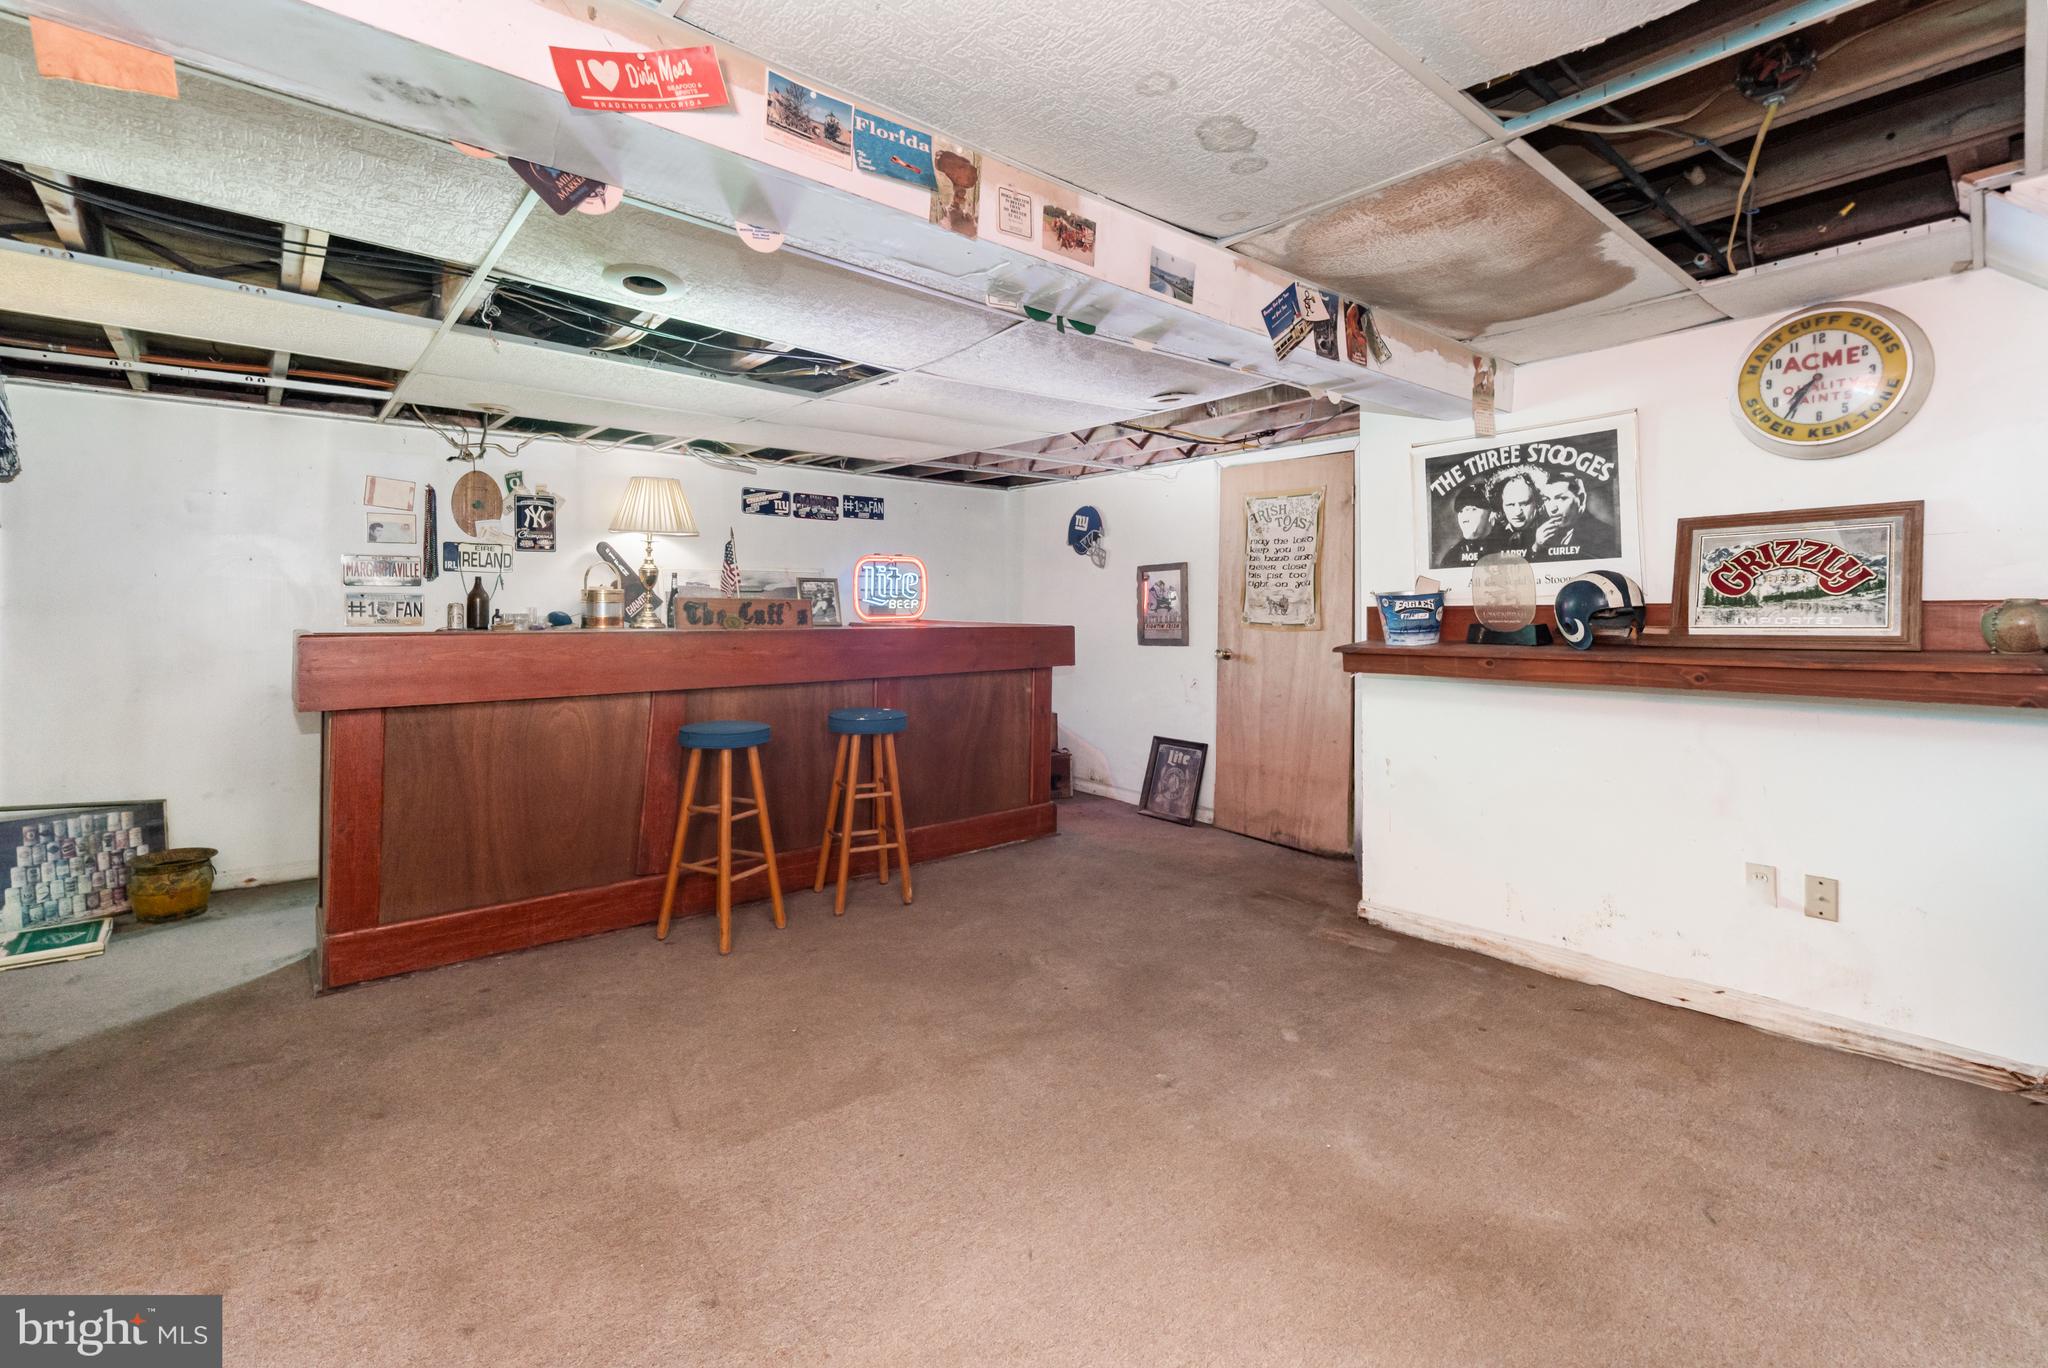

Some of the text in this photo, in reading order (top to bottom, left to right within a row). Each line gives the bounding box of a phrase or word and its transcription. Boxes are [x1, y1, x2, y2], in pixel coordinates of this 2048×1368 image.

[576, 59, 591, 89] I
[624, 61, 664, 99] Dirty
[854, 115, 931, 154] Florida
[1788, 315, 1842, 335] CUFF
[1849, 316, 1901, 355] SIGNS
[1812, 332, 1826, 345] 12
[1789, 342, 1799, 354] 11
[1861, 345, 1869, 357] 2
[1769, 358, 1783, 371] 10
[1783, 345, 1861, 375] ACME
[1765, 379, 1773, 390] 9
[1841, 402, 1849, 413] 5
[1746, 399, 1795, 436] SUPER
[1815, 411, 1823, 422] 6
[1430, 443, 1615, 497] THE THREE STOOGES
[843, 499, 860, 513] #1
[868, 501, 884, 514] FAN
[523, 504, 547, 529] NY
[1249, 504, 1288, 524] IRISH
[1275, 515, 1314, 532] TOAST
[1273, 537, 1289, 545] the
[1273, 547, 1292, 555] you
[1461, 552, 1479, 561] MOE
[1547, 545, 1581, 556] CURLEY
[346, 561, 420, 578] MARGARITAVILLE
[444, 560, 458, 569] IRL
[1282, 563, 1307, 571] close
[1708, 538, 1879, 598] GRIZZLY
[1266, 572, 1283, 580] fist
[1288, 571, 1307, 579] too
[1765, 574, 1809, 584] BEER
[861, 565, 919, 606] Lite
[1294, 580, 1312, 589] you
[347, 601, 423, 618] #1 FAN
[888, 599, 919, 609] BEER
[1394, 598, 1435, 612] EAGLES
[683, 601, 727, 625] The
[1734, 616, 1844, 626] IMPORTED
[1167, 749, 1191, 766] Lite
